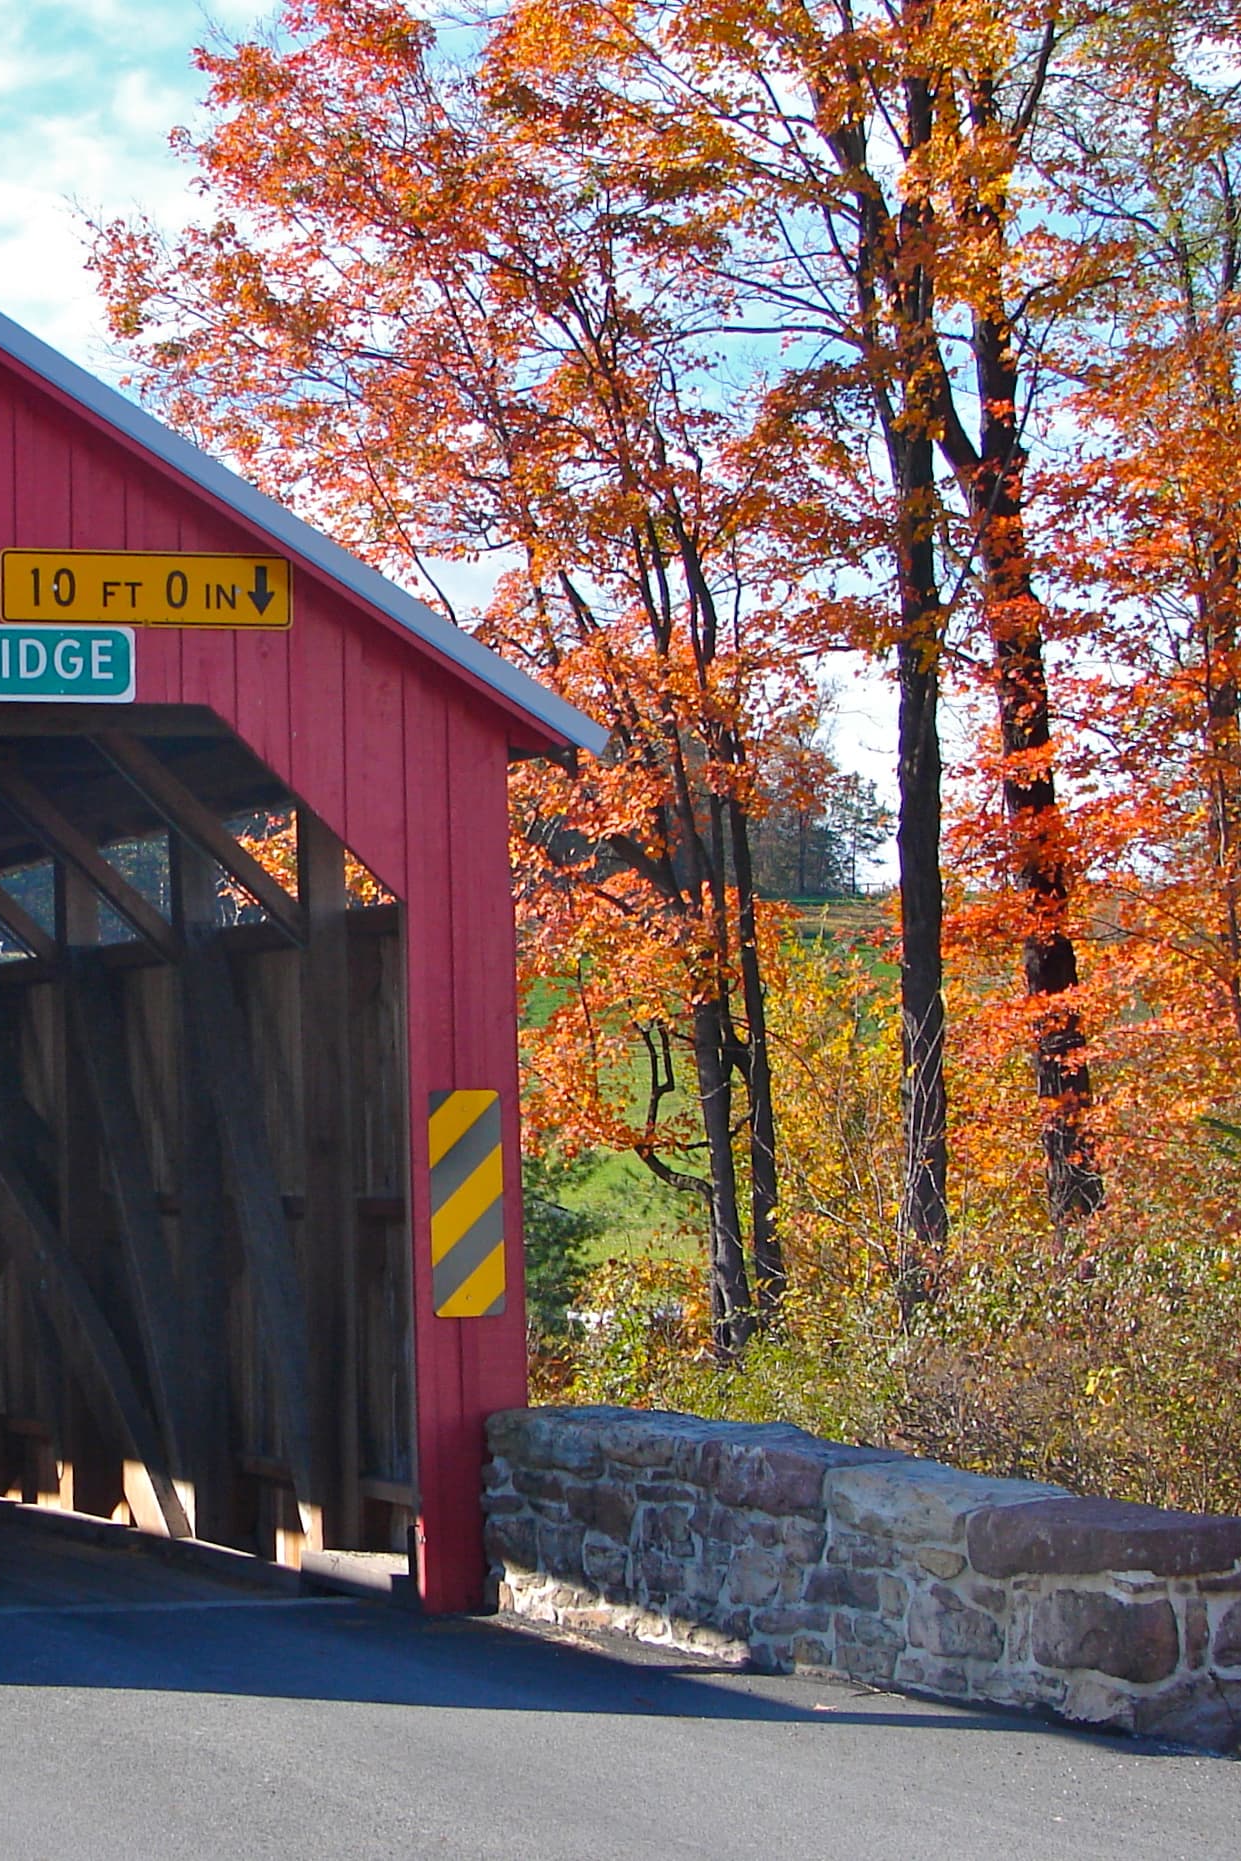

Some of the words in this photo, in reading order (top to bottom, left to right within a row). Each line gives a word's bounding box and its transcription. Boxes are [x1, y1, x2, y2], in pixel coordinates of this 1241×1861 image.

[30, 567, 77, 608] 10
[100, 581, 143, 609] FT
[164, 569, 190, 609] 0
[205, 582, 237, 610] IN
